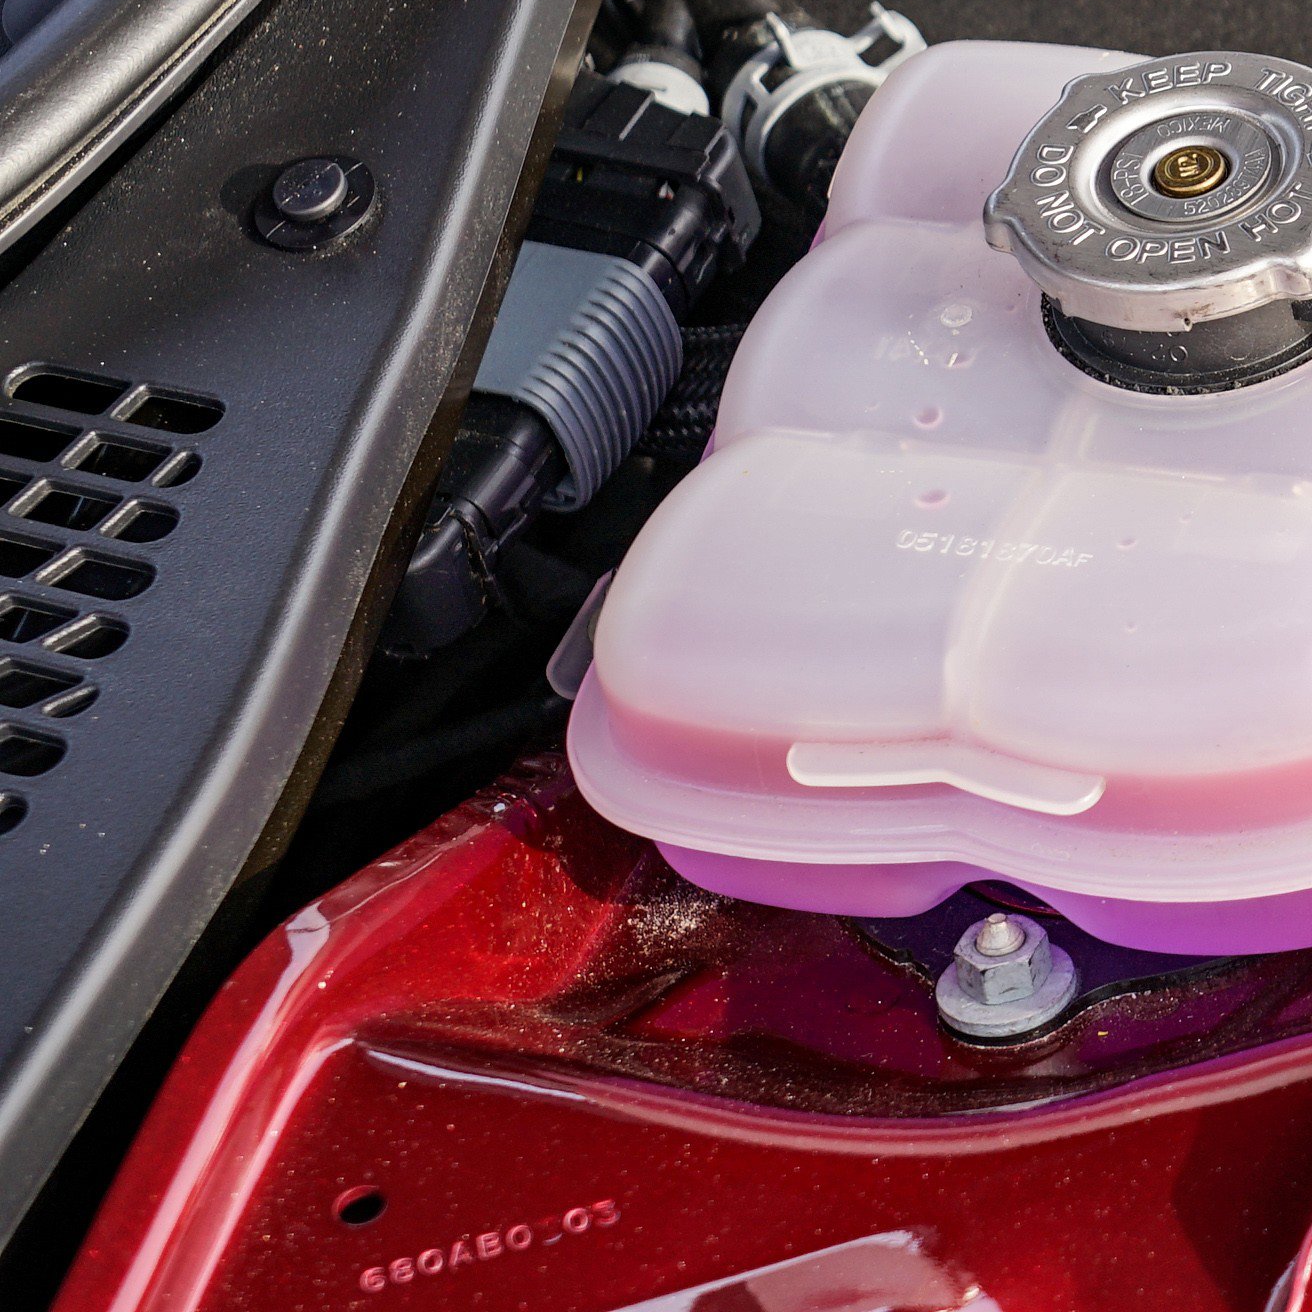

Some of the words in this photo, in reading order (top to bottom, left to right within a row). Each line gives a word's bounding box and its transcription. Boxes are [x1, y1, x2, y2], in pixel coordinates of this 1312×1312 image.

[1108, 62, 1232, 105] KEEP
[1031, 144, 1074, 187] DO
[1034, 190, 1106, 245] NOT
[1105, 229, 1231, 265] OPEN
